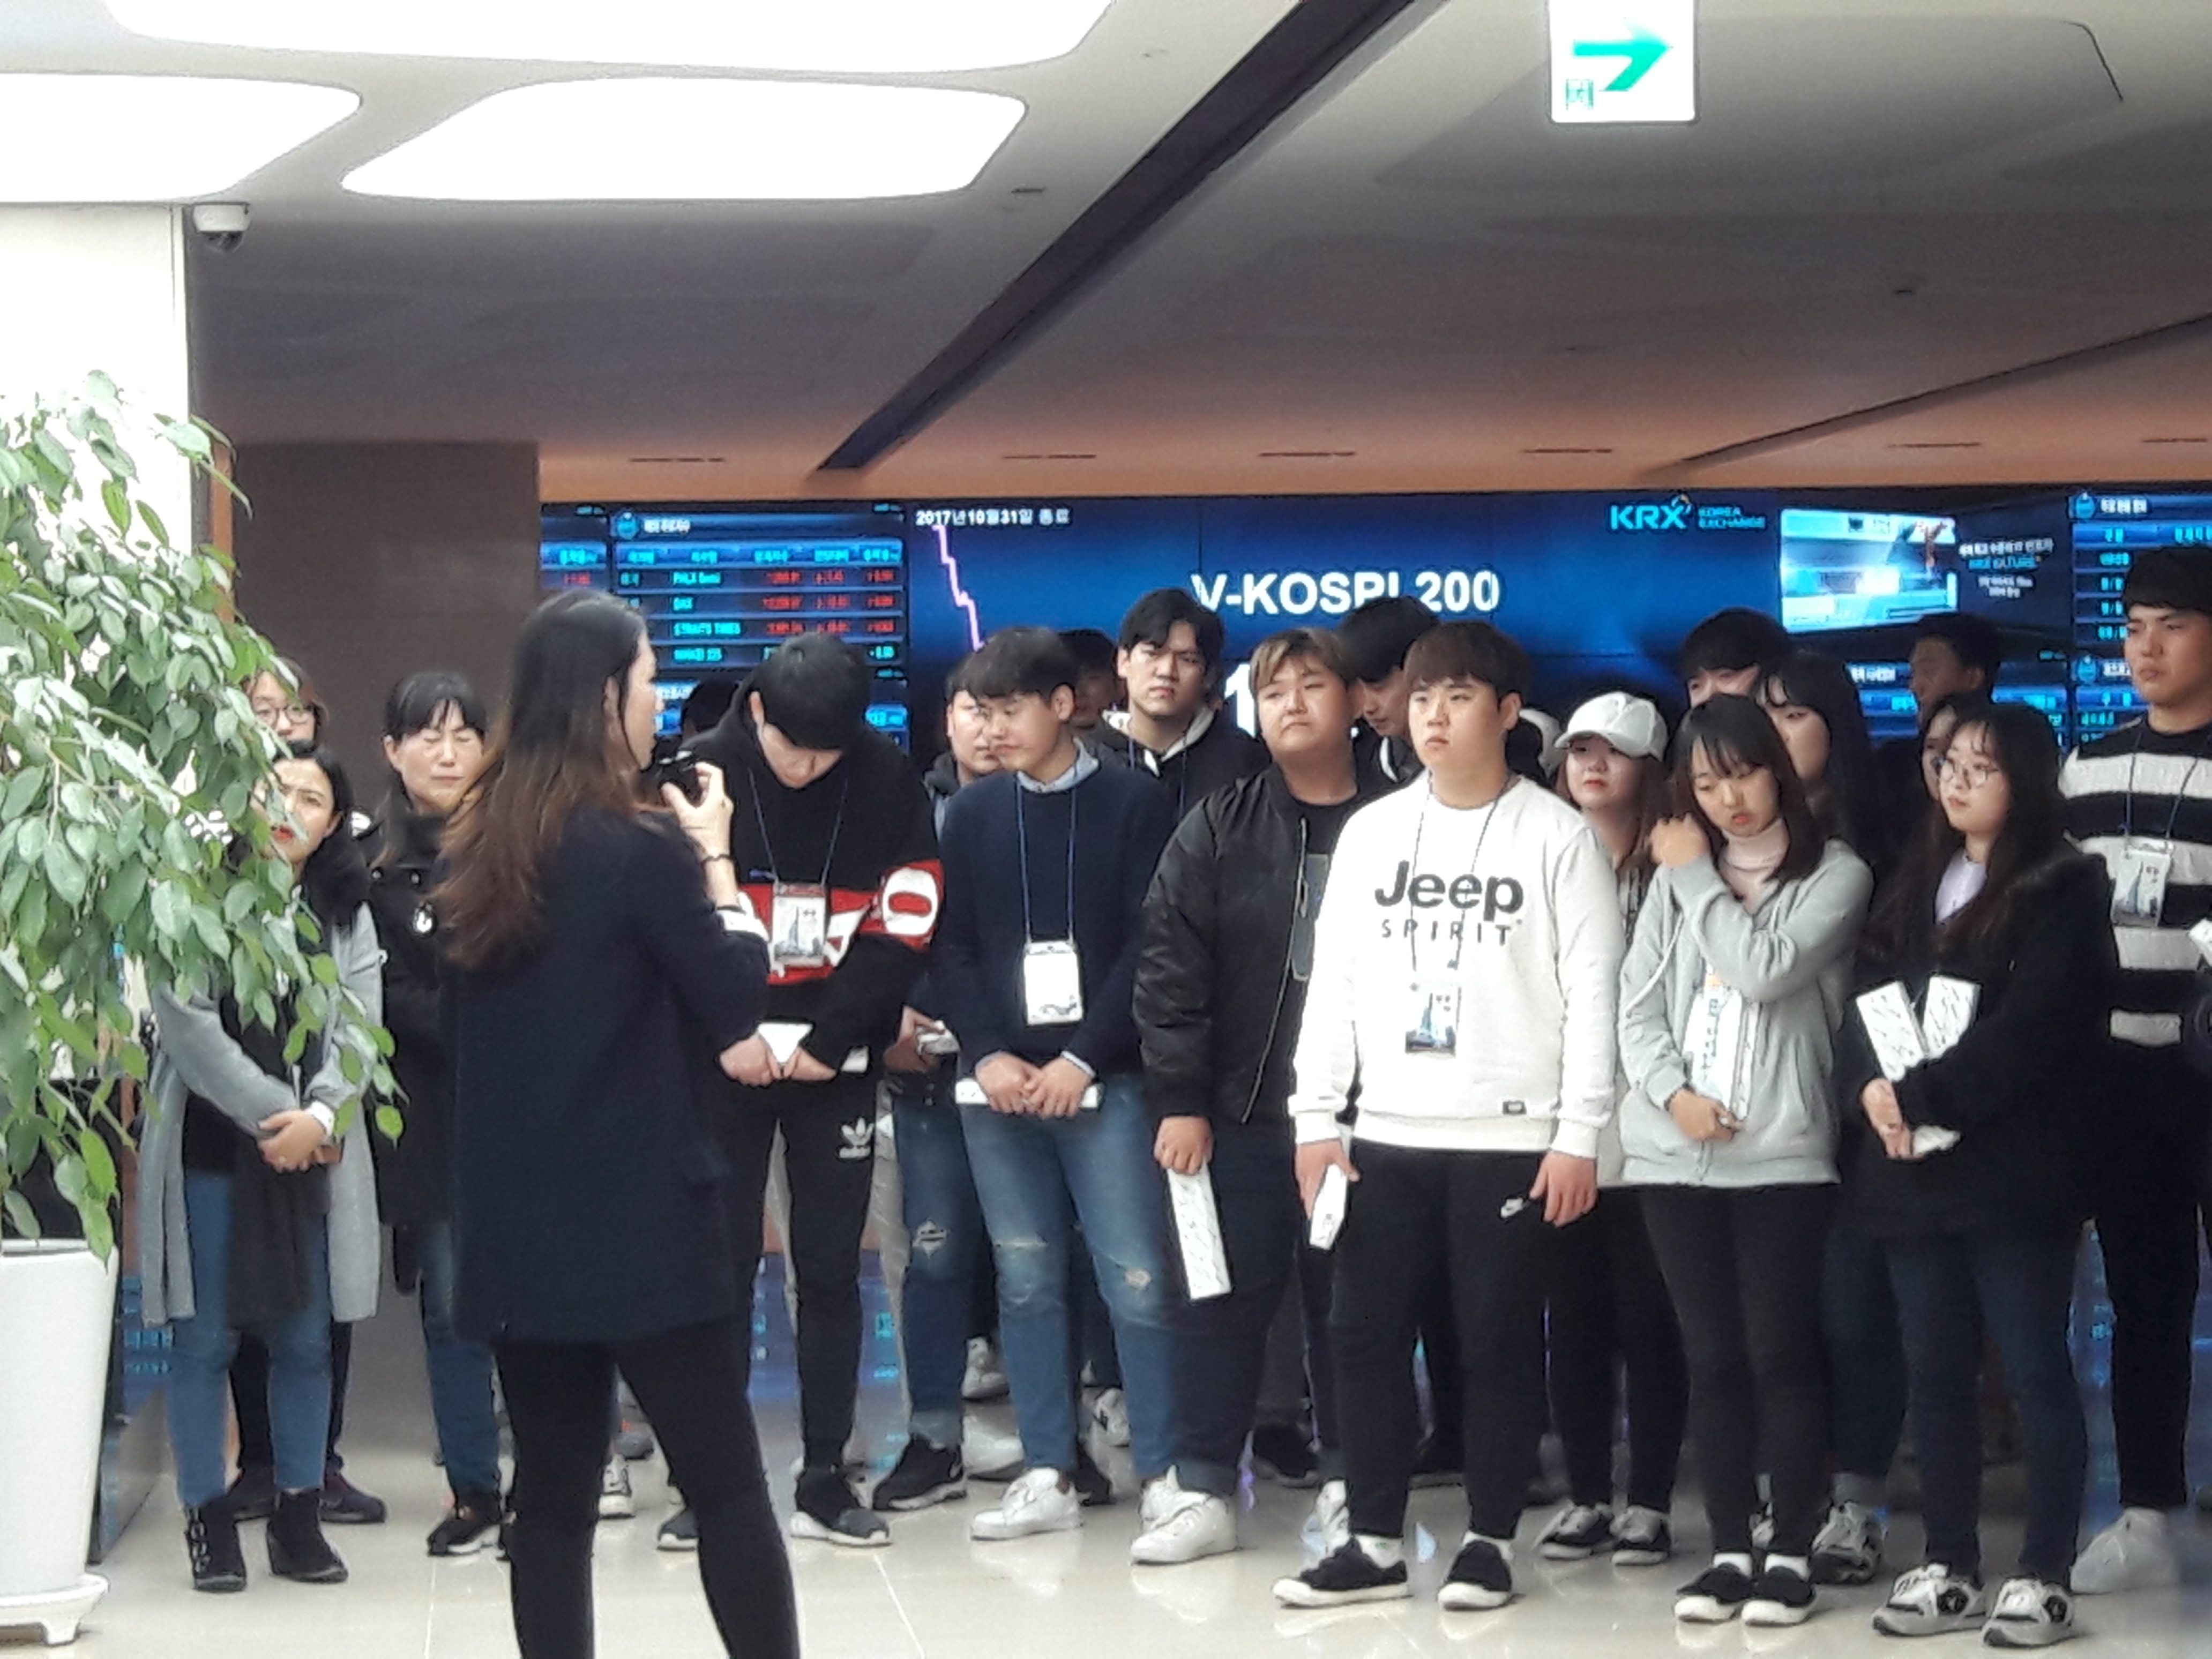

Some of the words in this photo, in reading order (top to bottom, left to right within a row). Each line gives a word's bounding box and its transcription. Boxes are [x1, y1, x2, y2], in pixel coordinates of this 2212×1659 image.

[1610, 505, 1686, 529] KRX
[1415, 570, 1499, 613] 200
[1374, 860, 1524, 922] Jeep
[1381, 918, 1511, 946] SPIRIT
